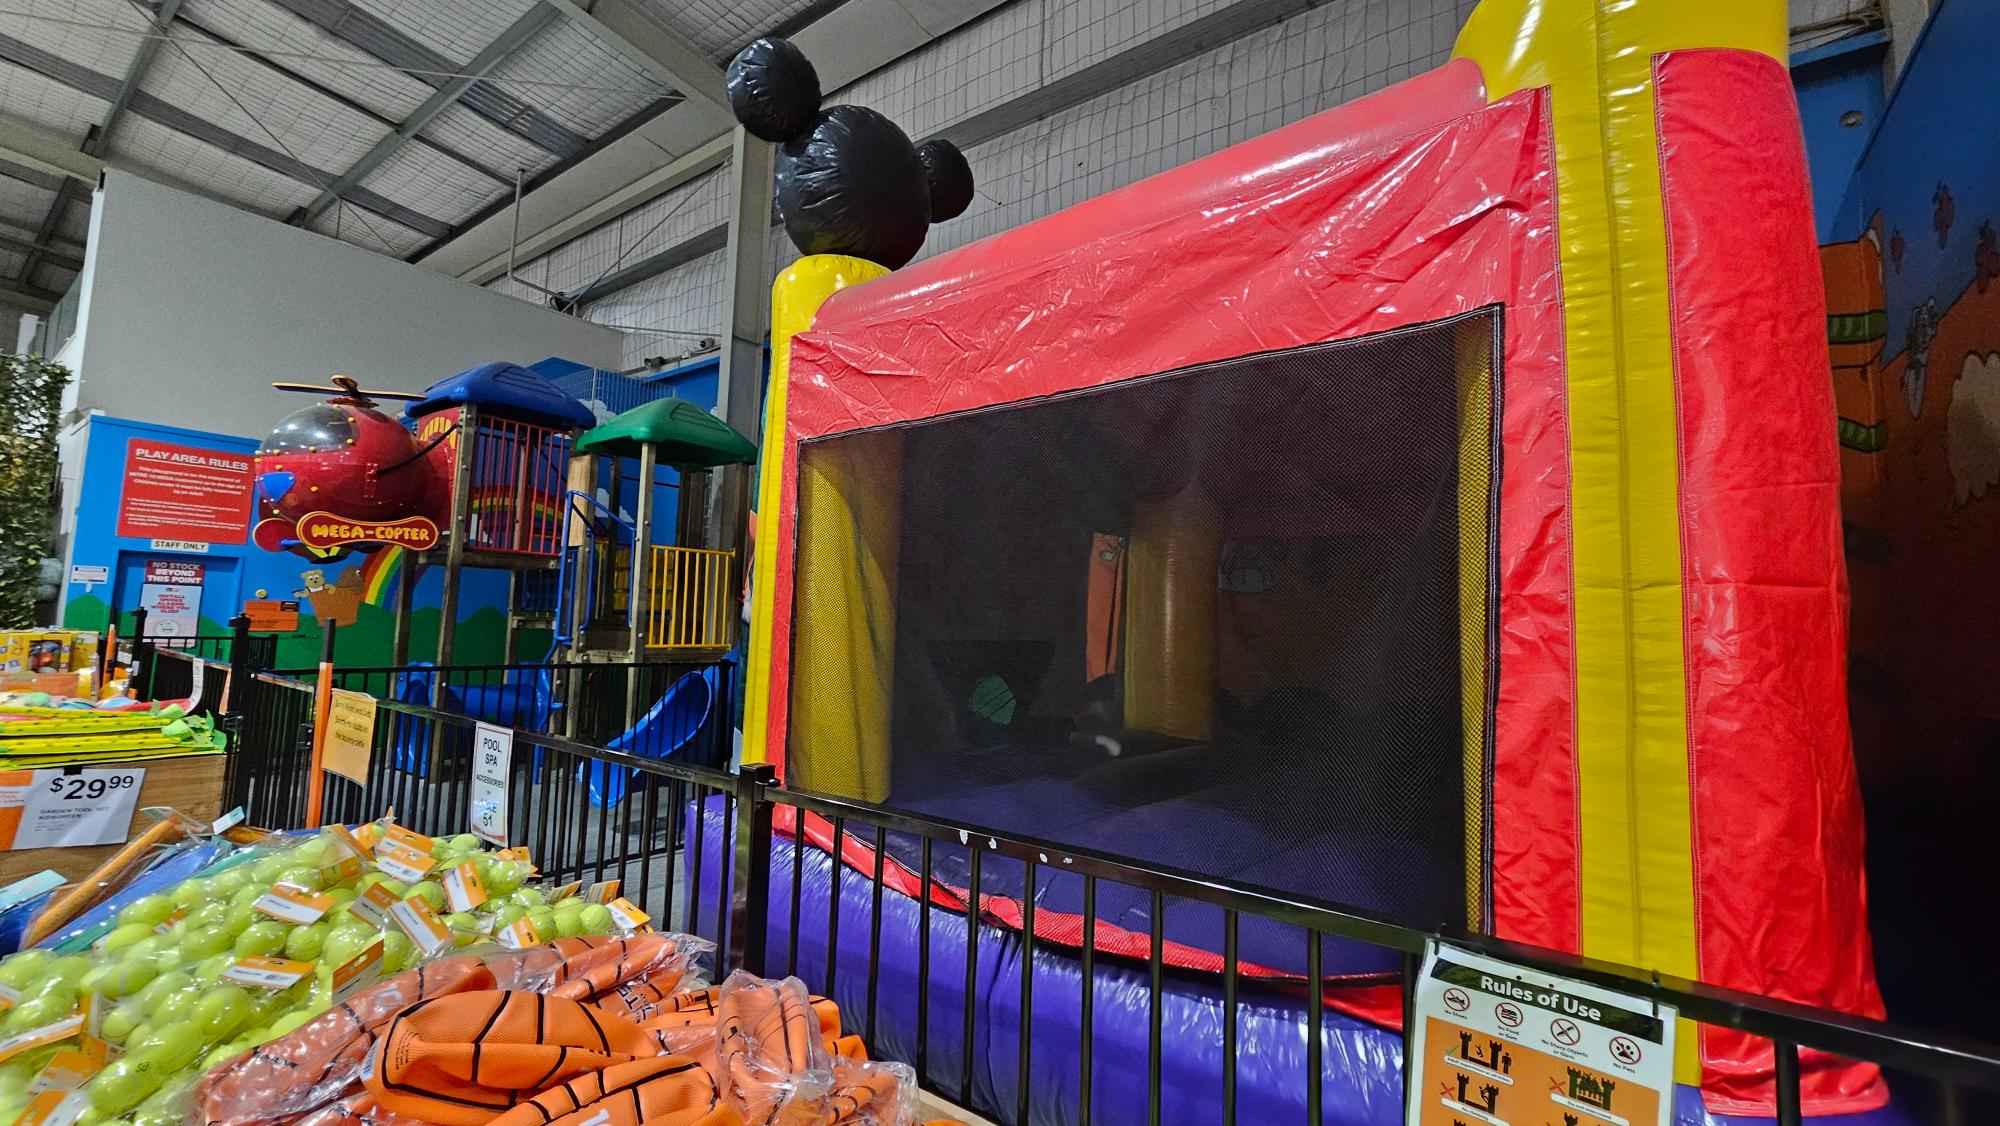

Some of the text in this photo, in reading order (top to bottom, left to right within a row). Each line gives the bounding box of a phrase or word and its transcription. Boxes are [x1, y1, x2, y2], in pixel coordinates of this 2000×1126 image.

[135, 448, 249, 471] PLAY AREA RULES
[311, 523, 430, 541] MEGA-COPTER
[154, 540, 206, 550] STAFF ONLY
[151, 561, 200, 571] NO STOCK
[155, 568, 195, 577] BEYOND
[147, 575, 202, 584] THIS POINT
[483, 737, 502, 754] POOL
[485, 753, 498, 767] SPA
[1481, 975, 1602, 1021] Rules of Use
[1452, 1011, 1468, 1020] Shoes
[1506, 1027, 1520, 1036] Food
[1550, 1041, 1567, 1051] Sharp
[1567, 1047, 1588, 1058] Objects
[1560, 1051, 1575, 1060] Glass
[1622, 1065, 1636, 1074] Pets
